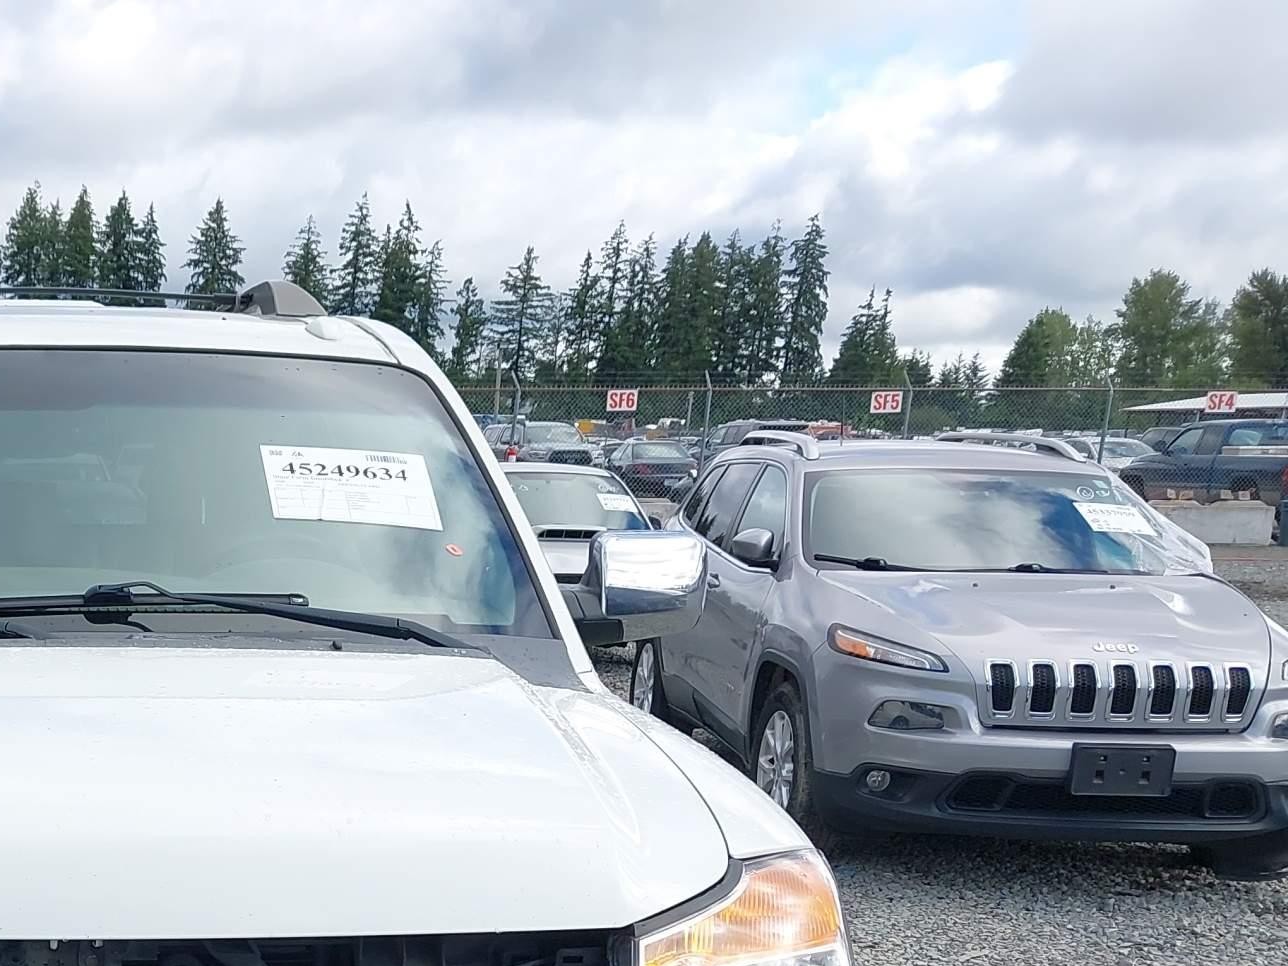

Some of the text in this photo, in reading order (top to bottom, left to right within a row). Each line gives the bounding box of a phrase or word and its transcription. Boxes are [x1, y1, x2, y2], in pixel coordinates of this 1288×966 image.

[609, 391, 636, 409] SF6
[873, 393, 901, 410] SF5
[1207, 393, 1235, 410] SF4
[281, 461, 409, 482] 45249634
[1092, 640, 1140, 655] Jeep
